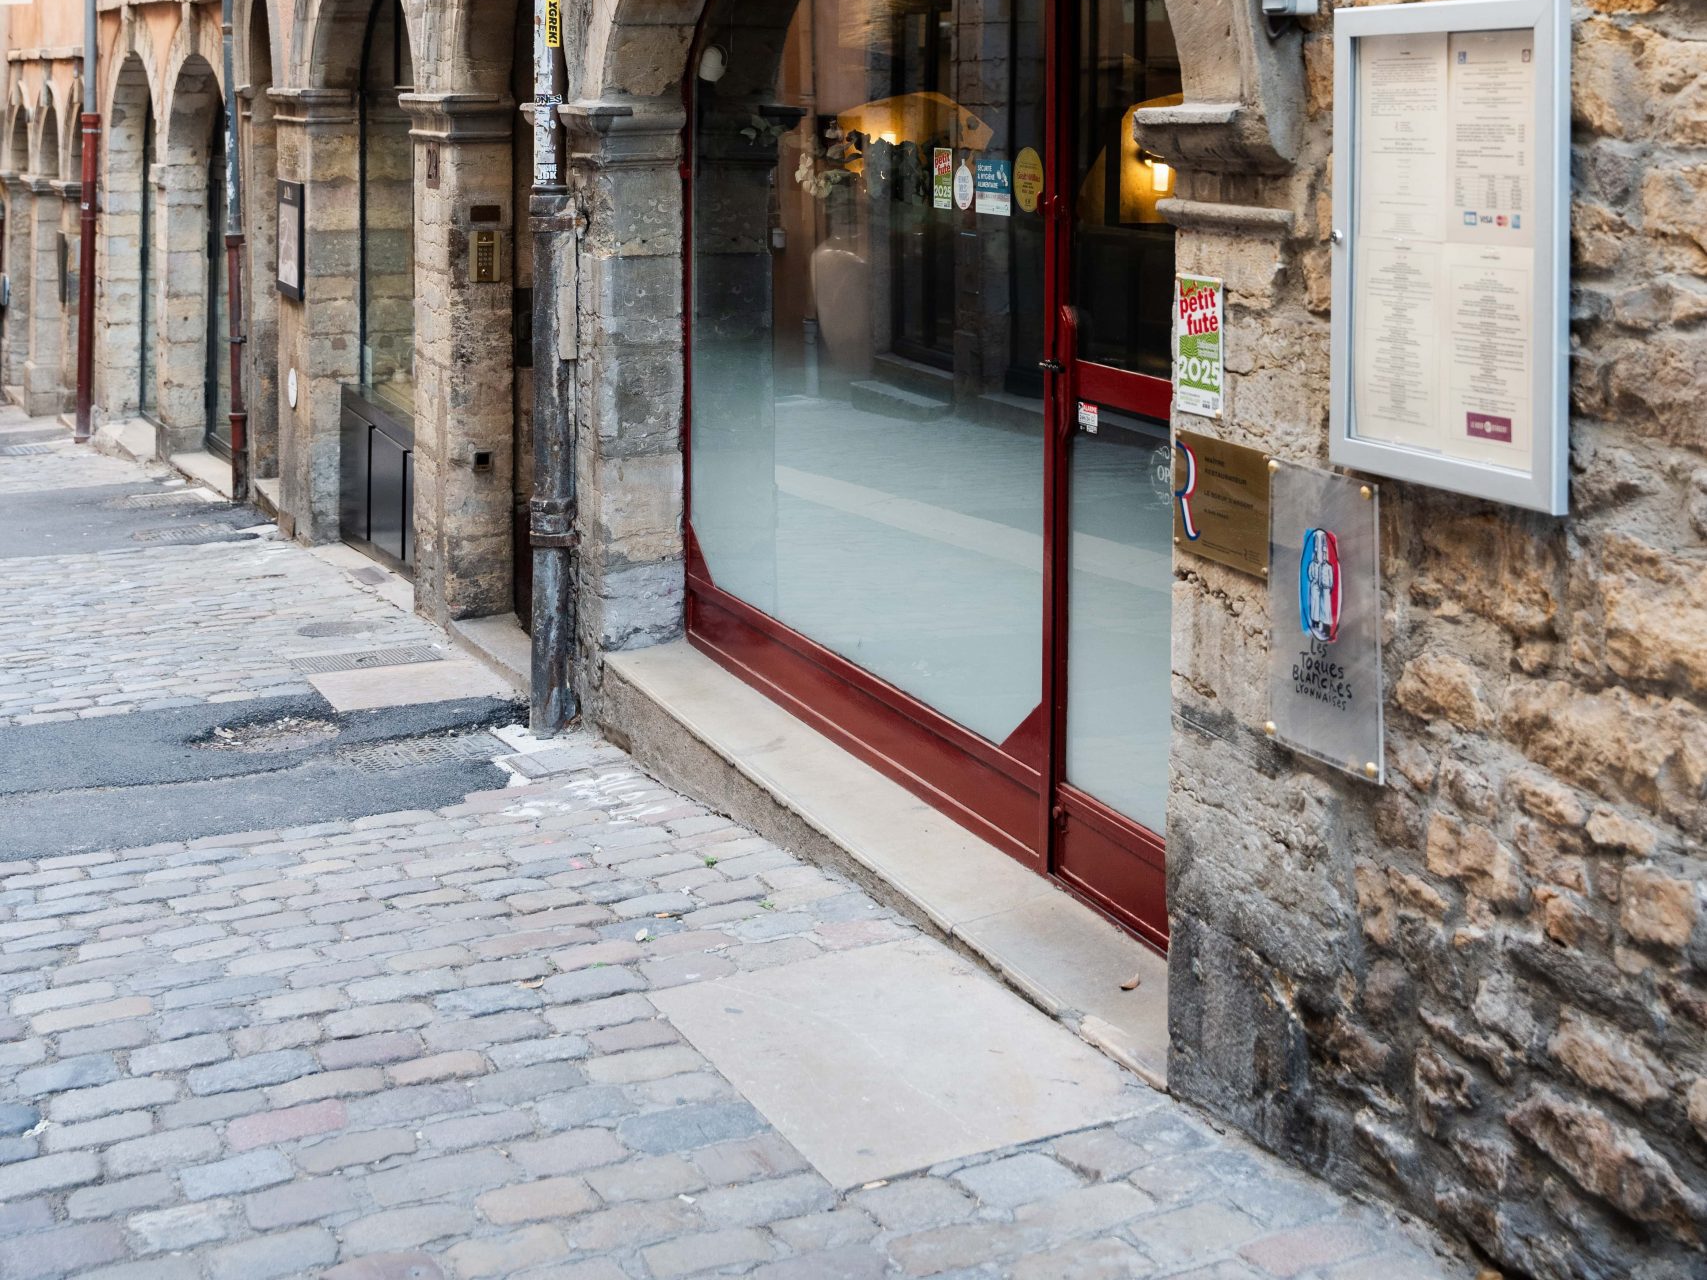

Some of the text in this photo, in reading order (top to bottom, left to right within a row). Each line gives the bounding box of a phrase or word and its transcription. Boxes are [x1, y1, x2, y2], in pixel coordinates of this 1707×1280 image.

[548, 1, 558, 44] YGREK!
[934, 152, 951, 169] petit
[937, 163, 952, 176] futé
[934, 184, 952, 198] 2025
[1180, 287, 1216, 320] petit
[1187, 310, 1219, 336] futé
[1178, 355, 1221, 387] 2025
[1156, 465, 1171, 483] OP
